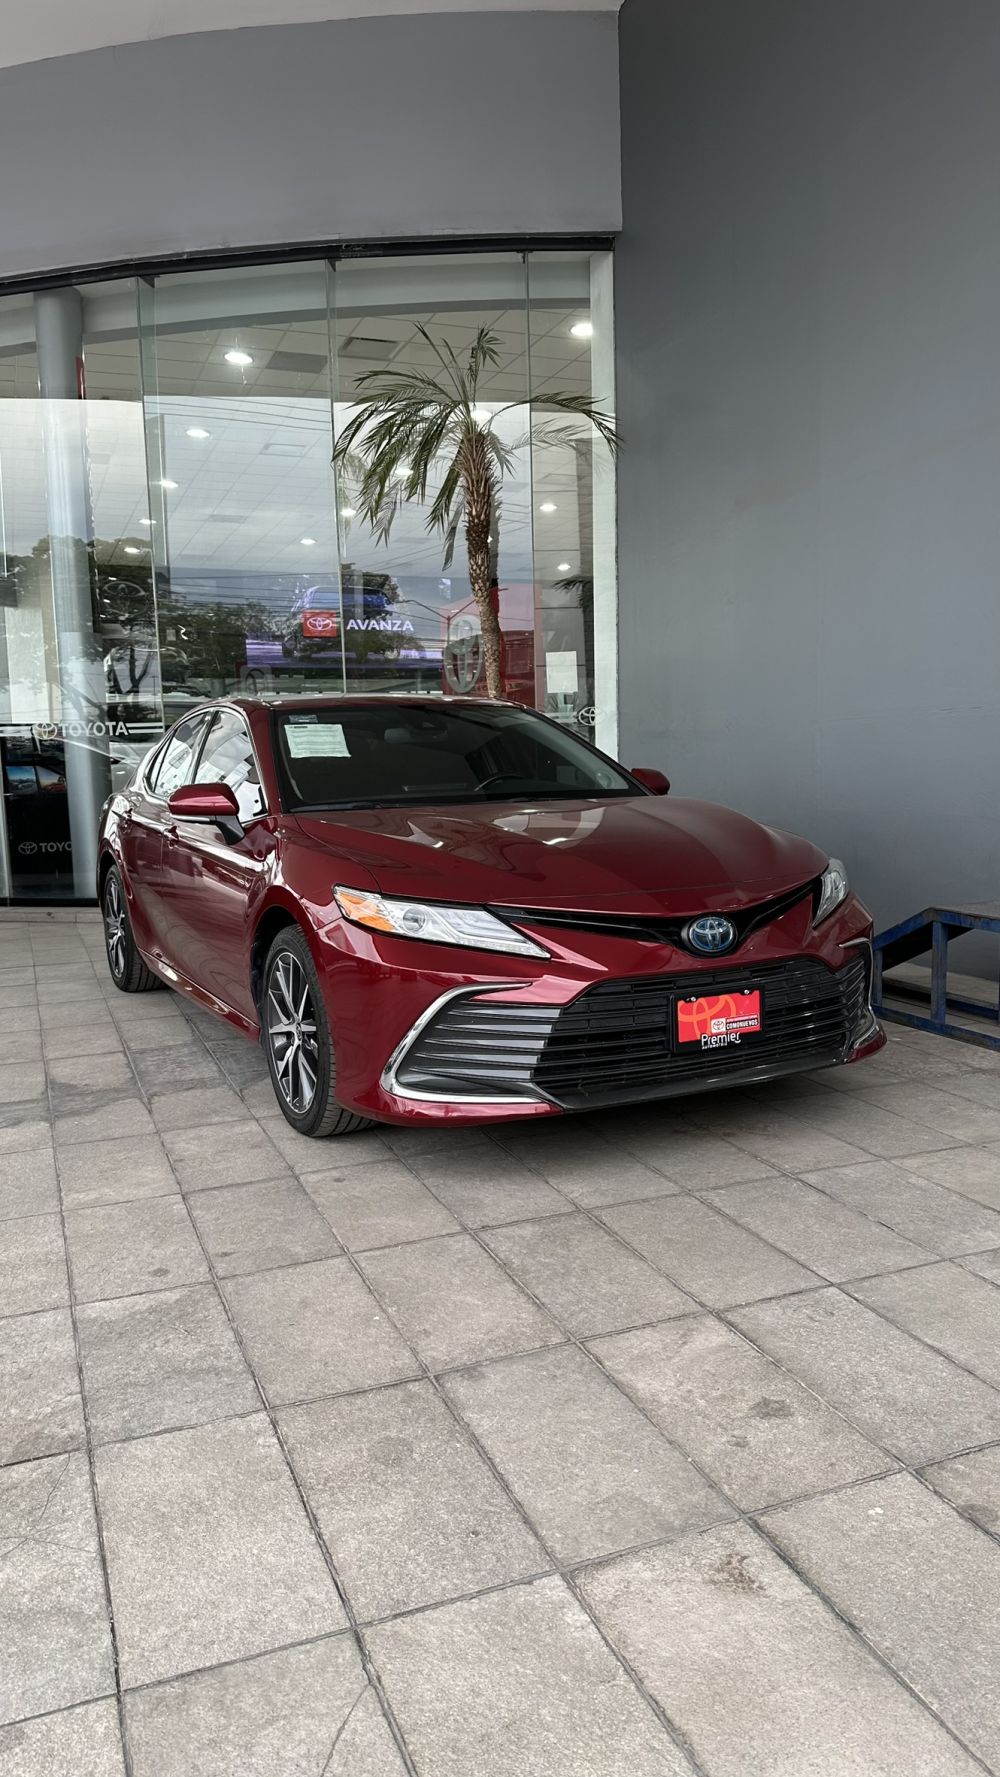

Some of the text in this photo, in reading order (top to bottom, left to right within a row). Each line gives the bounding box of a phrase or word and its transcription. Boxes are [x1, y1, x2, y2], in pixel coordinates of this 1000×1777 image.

[346, 619, 414, 631] AVANZA
[59, 721, 129, 737] TOYOTA
[39, 841, 72, 853] TOYO
[701, 1032, 741, 1046] Premier
